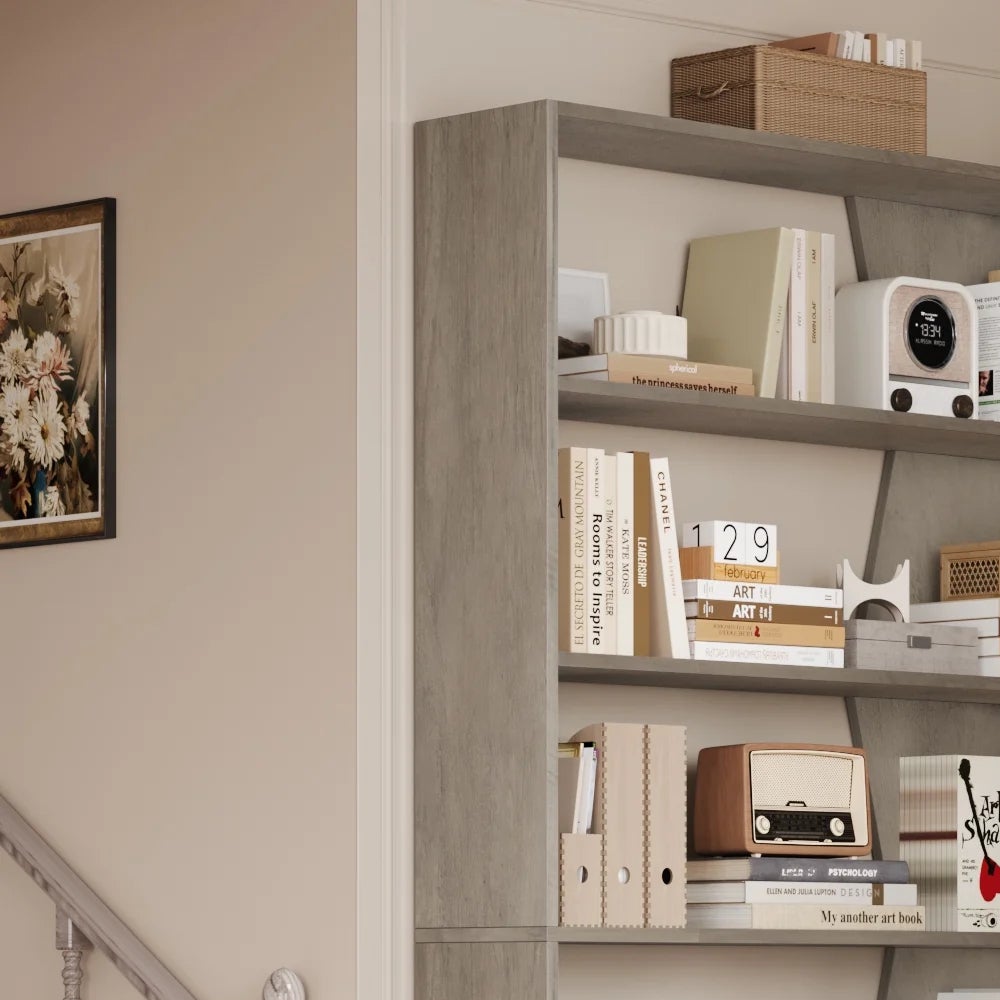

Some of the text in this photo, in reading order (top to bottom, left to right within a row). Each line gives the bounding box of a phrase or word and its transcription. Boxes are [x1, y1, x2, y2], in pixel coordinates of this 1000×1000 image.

[707, 382, 738, 395] herself
[574, 460, 584, 525] MOUNTAIN
[657, 471, 671, 535] CHANEL
[574, 527, 584, 557] GRAY
[723, 523, 770, 563] 29
[637, 536, 648, 588] LEADERSHIP
[574, 564, 584, 579] DE
[590, 513, 603, 646] Rooms to Inspire
[723, 563, 766, 582] february
[732, 585, 756, 600] ART
[605, 589, 613, 616] TELLER
[732, 603, 758, 620] ART
[828, 867, 878, 878] PSYCHOLOGY
[766, 887, 783, 895] ELLEN
[797, 888, 813, 896] JULIA
[814, 888, 837, 896] LUPTON
[840, 887, 880, 897] DESIGN
[821, 910, 923, 926] My another art book
